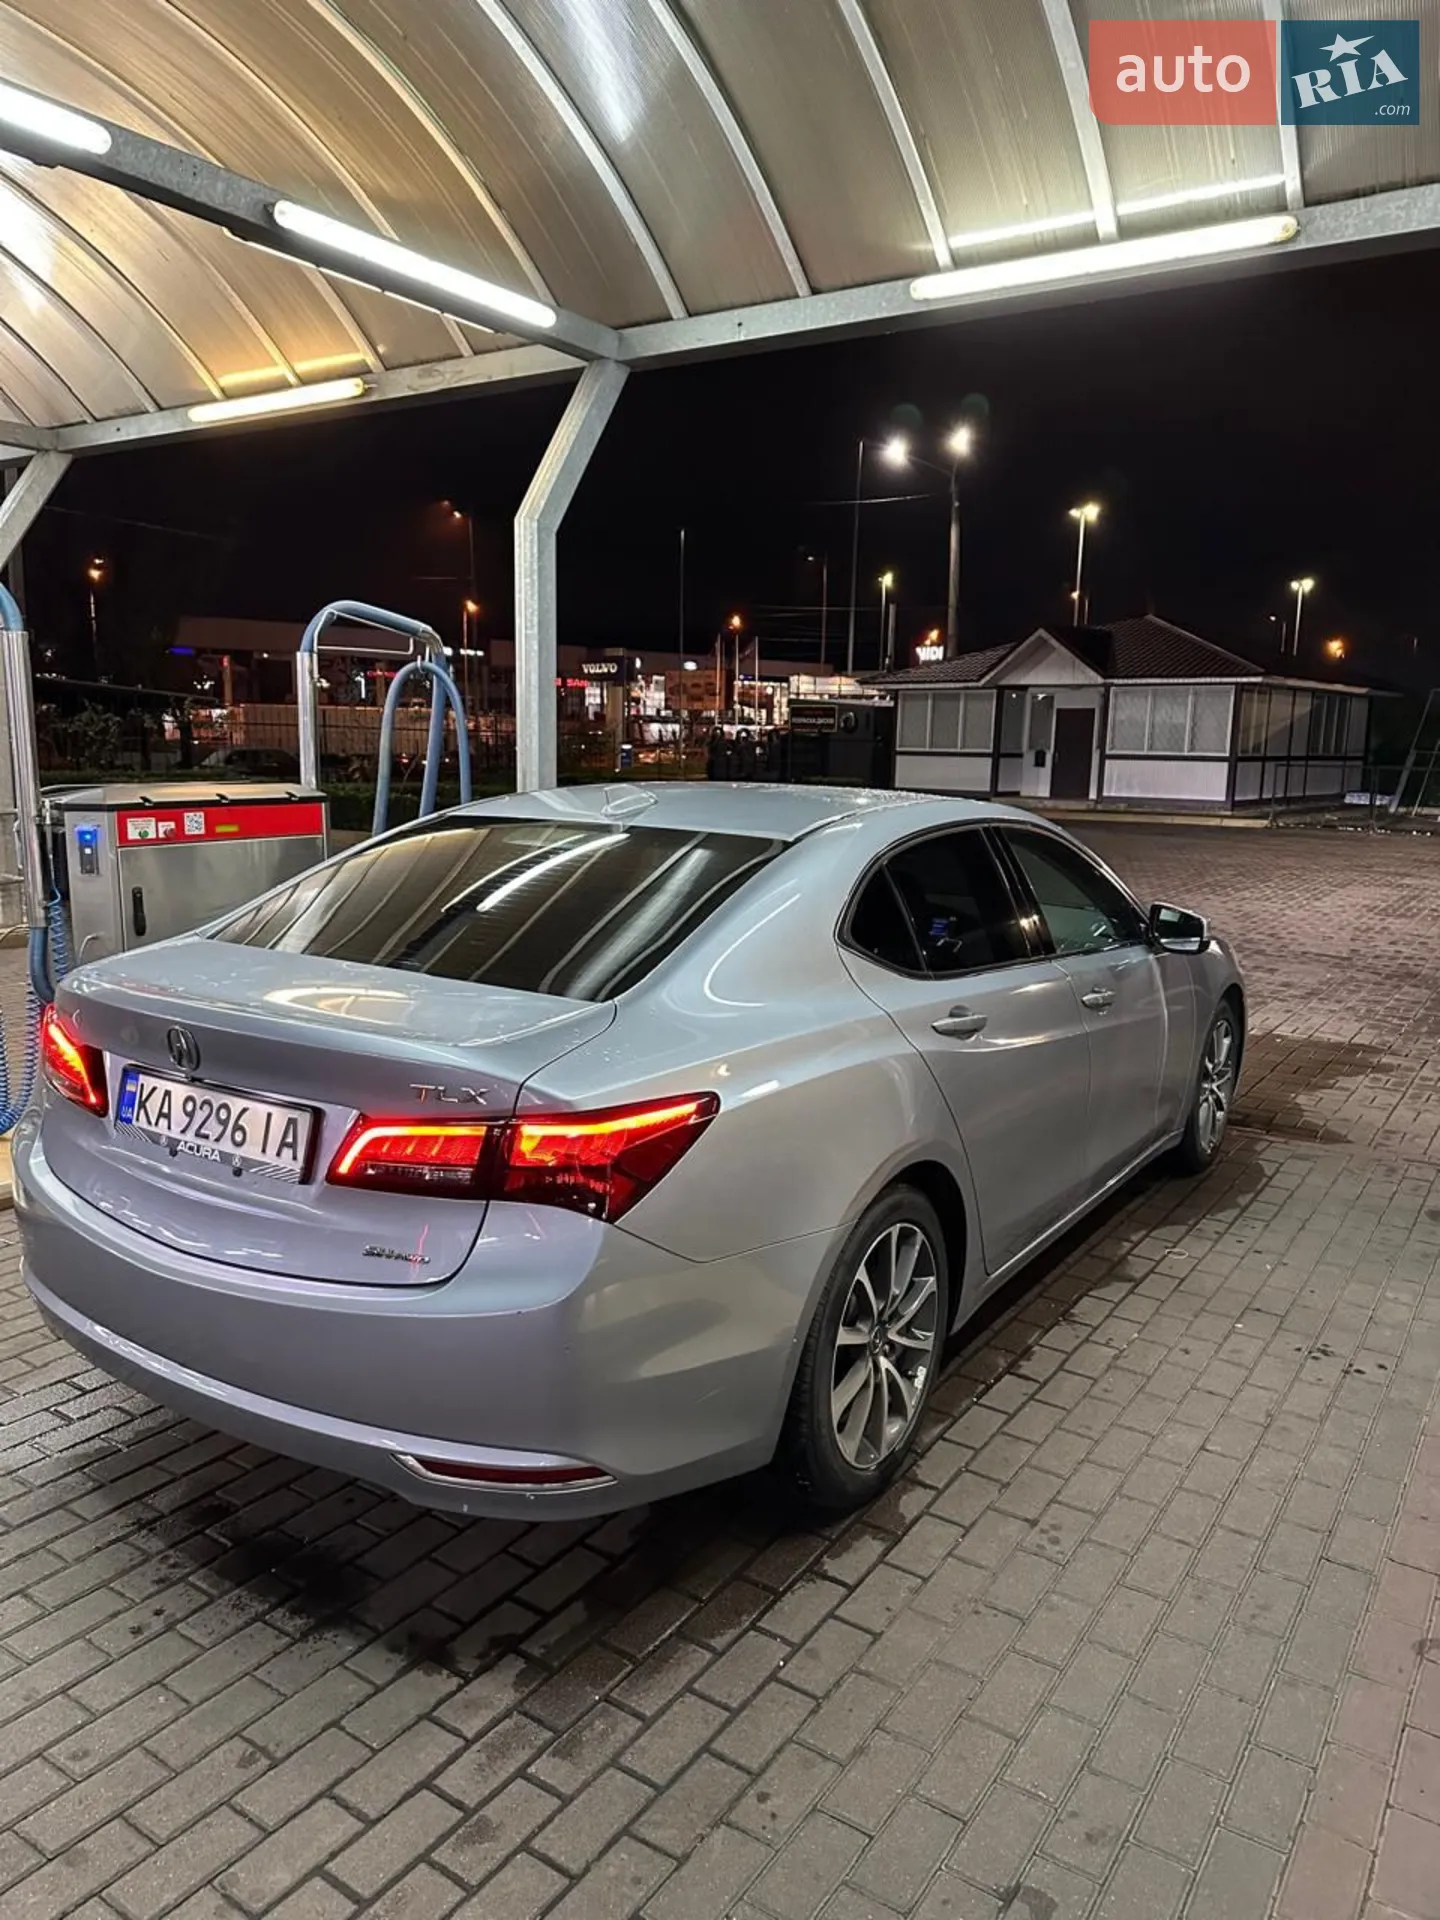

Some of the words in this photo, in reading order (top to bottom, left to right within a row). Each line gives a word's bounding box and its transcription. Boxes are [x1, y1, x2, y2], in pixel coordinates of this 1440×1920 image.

[915, 646, 944, 663] VIDI
[582, 663, 618, 674] VOLVO
[409, 1083, 489, 1106] TLX
[120, 1106, 133, 1118] UA
[135, 1083, 173, 1131] KA
[180, 1094, 250, 1148] 9296
[261, 1112, 299, 1161] IA
[176, 1140, 221, 1162] ACURA
